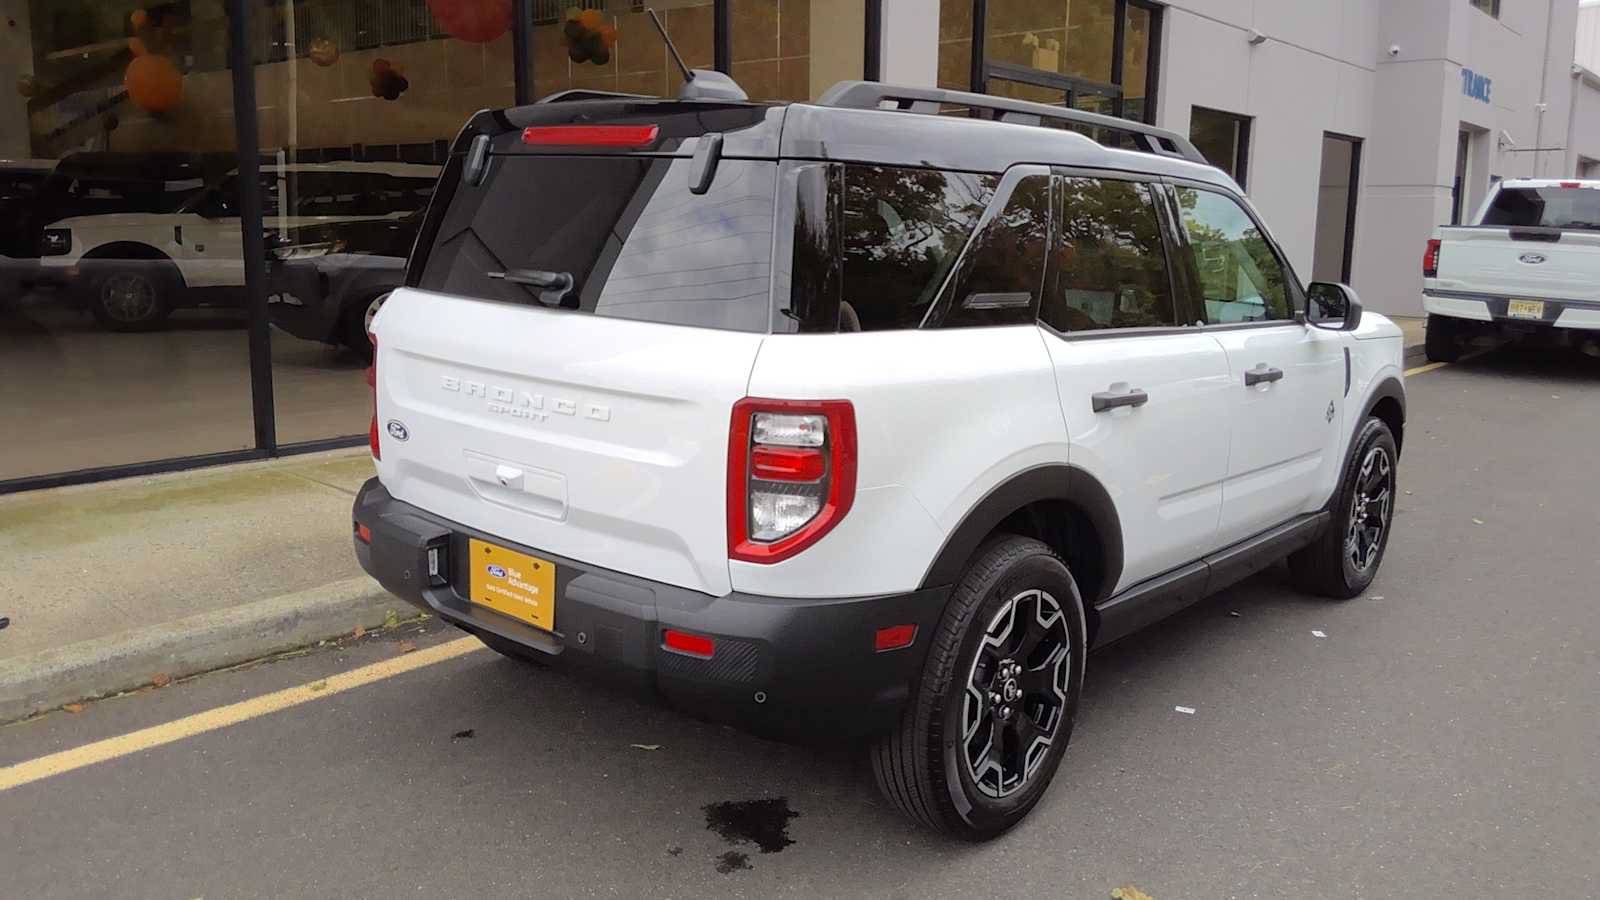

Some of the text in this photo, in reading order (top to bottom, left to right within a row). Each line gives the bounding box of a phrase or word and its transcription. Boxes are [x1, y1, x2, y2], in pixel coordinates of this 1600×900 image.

[1519, 255, 1545, 265] Ford
[440, 375, 612, 422] BRONCO
[487, 402, 550, 423] SPORT
[388, 420, 408, 441] Ford
[487, 564, 506, 578] Ford
[507, 567, 522, 579] Blue
[508, 577, 539, 595] Advantage
